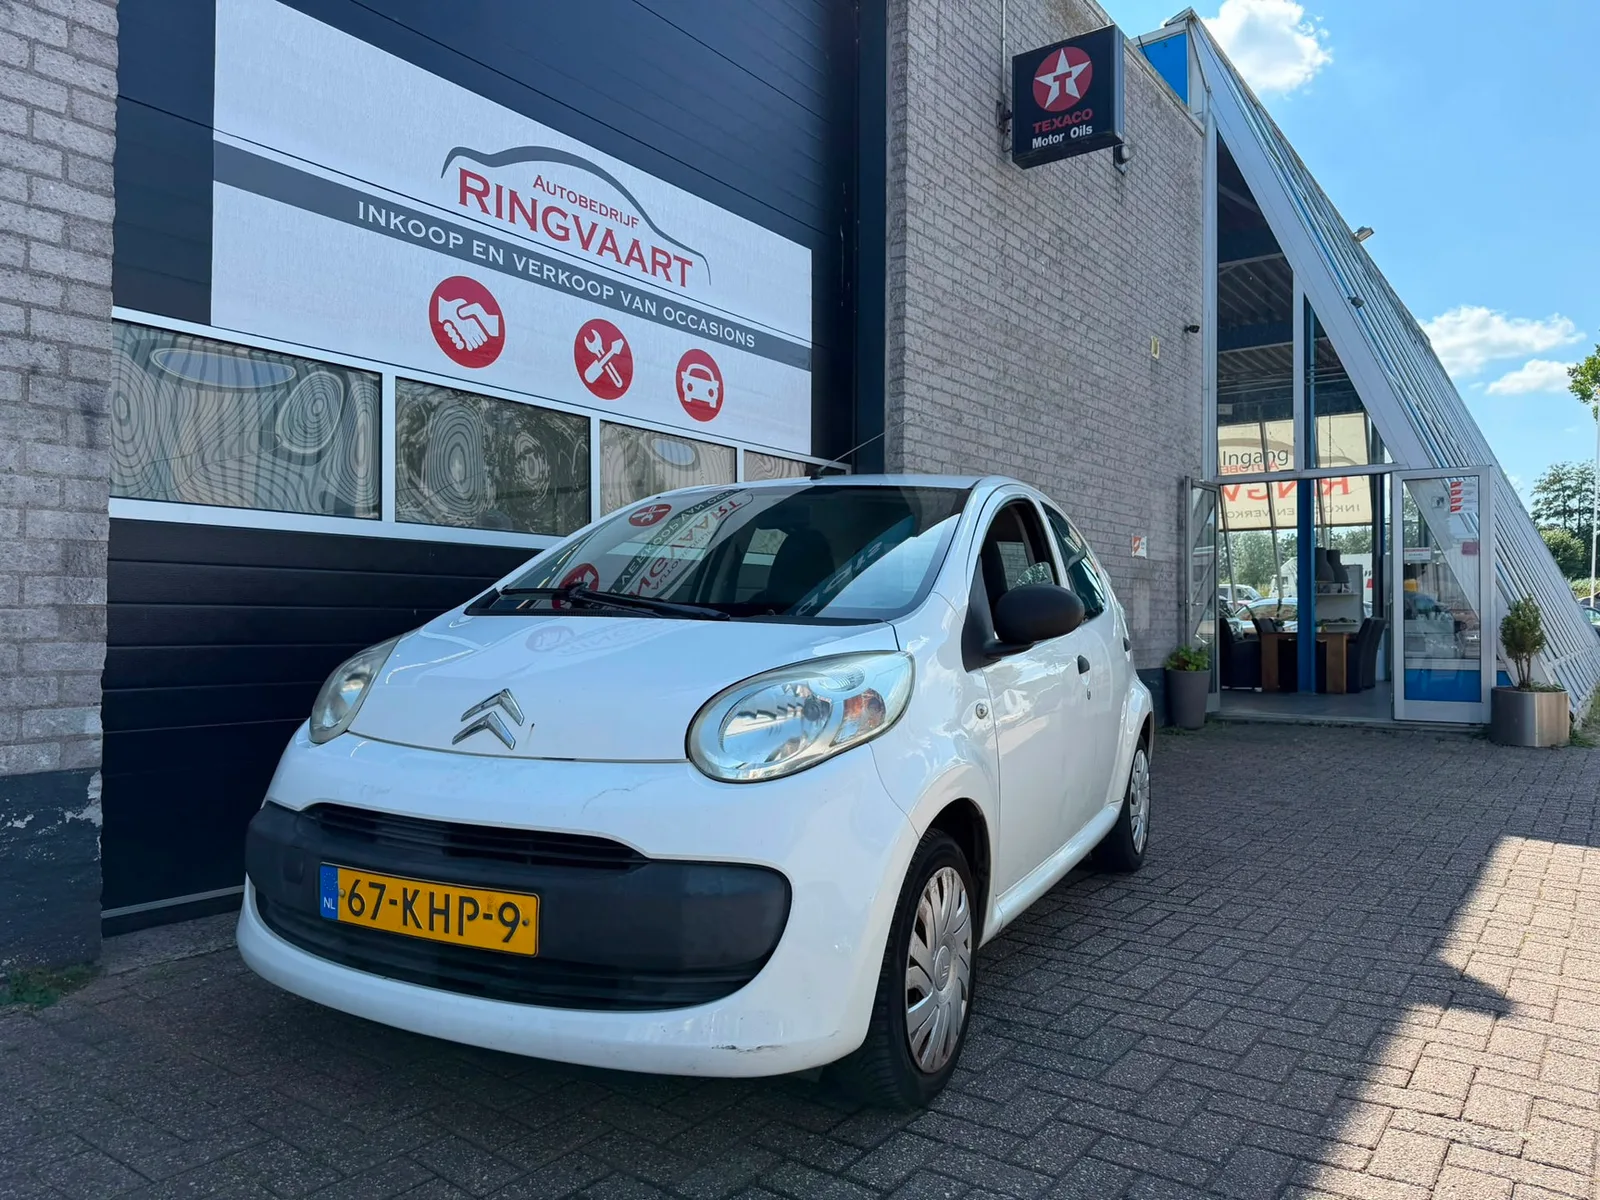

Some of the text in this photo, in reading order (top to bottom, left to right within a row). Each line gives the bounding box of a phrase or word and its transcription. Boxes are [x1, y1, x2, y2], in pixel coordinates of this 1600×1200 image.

[1032, 108, 1093, 134] TEXACO
[1032, 124, 1093, 149] Motor Oils
[458, 167, 693, 288] RINGVAART
[533, 174, 640, 229] AUTOBEDRIJF
[357, 201, 756, 348] INKOOP EN VERKOOP VAN OCCASIONS
[1223, 449, 1289, 469] Ingang
[323, 878, 521, 944] NL 67-KHP-9
